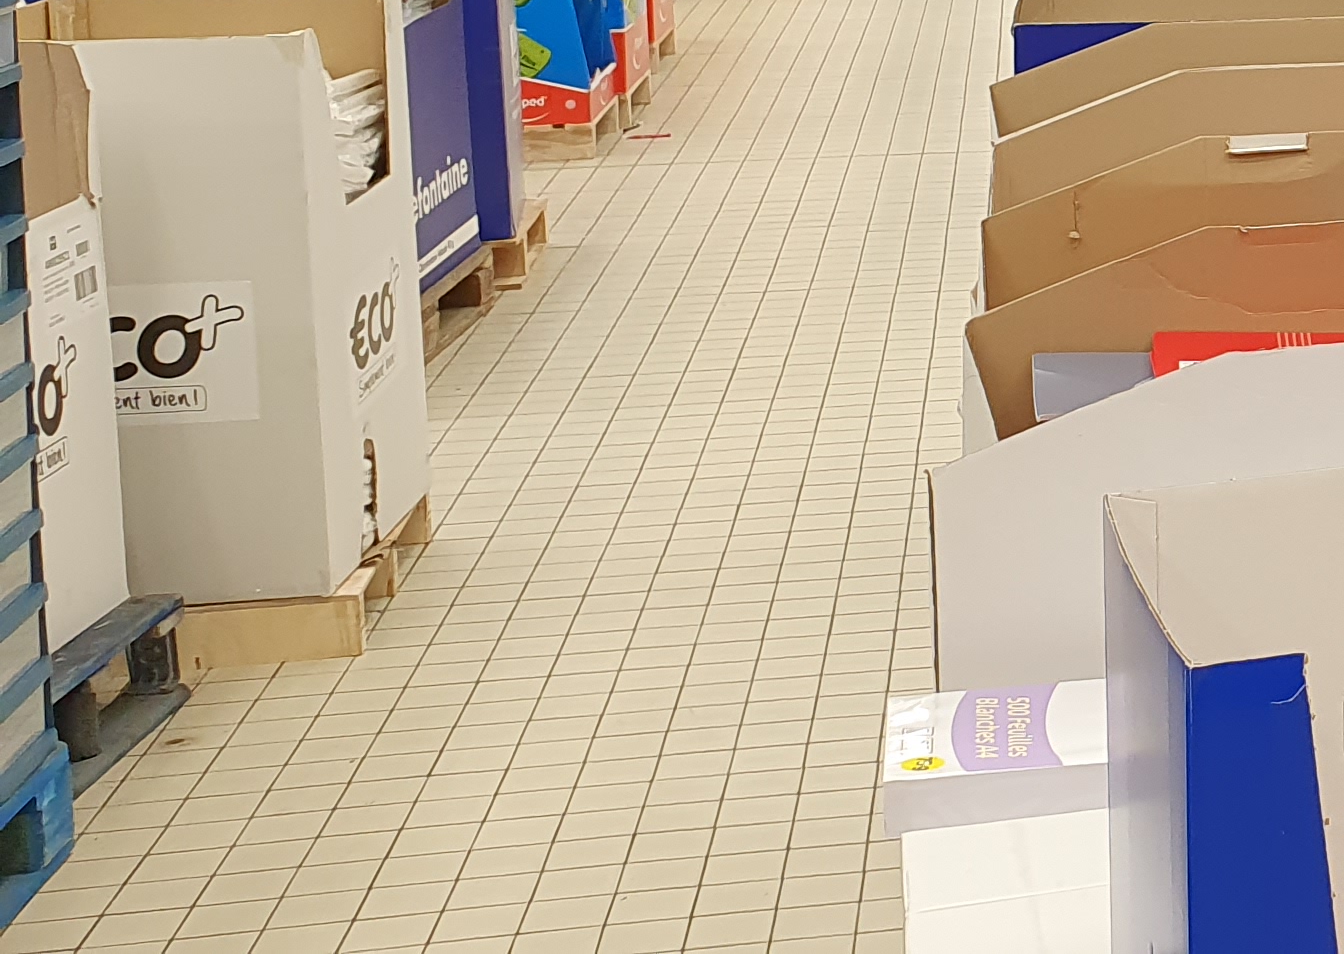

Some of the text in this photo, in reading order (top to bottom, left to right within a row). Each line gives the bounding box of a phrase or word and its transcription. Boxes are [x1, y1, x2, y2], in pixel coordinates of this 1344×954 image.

[975, 696, 1000, 759] Blanches A4
[1006, 696, 1034, 758] 500 Feuilles
